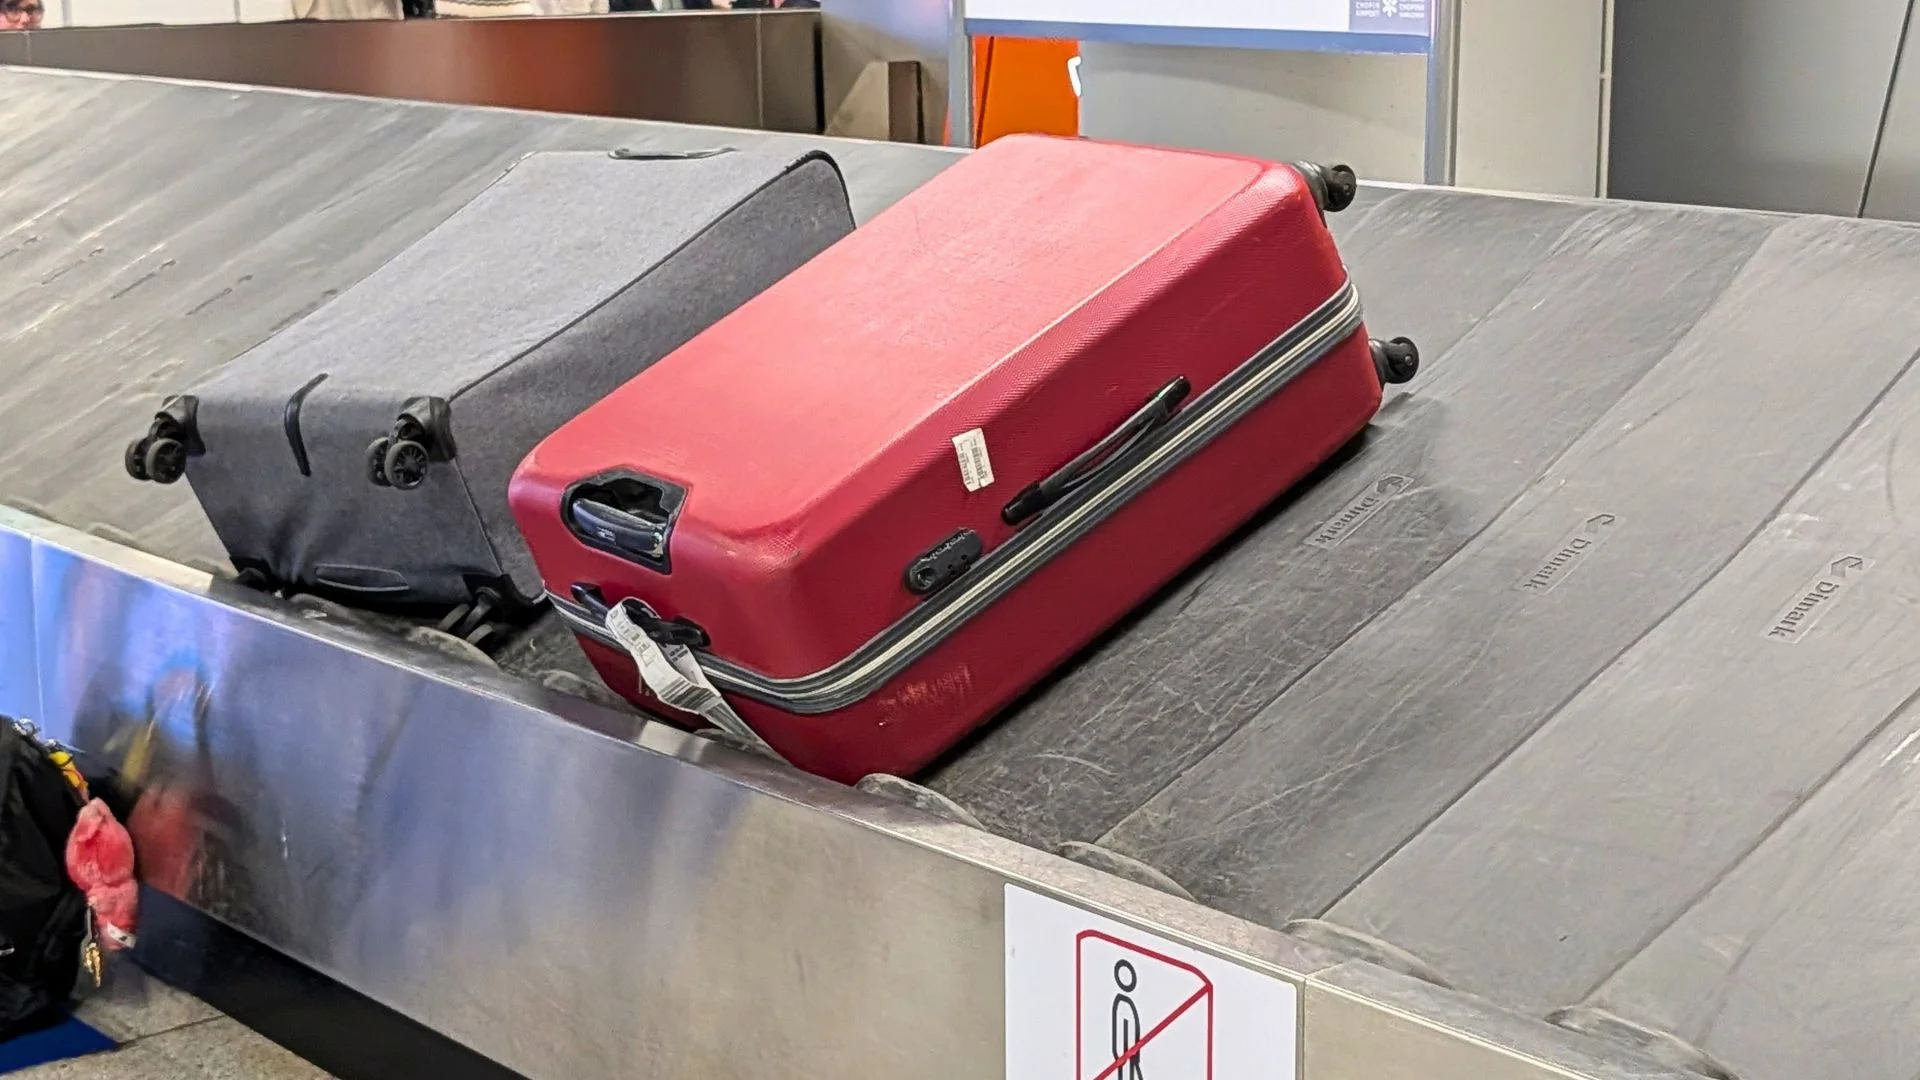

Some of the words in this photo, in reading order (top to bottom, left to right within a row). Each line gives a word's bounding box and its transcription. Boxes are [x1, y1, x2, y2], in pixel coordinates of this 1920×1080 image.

[1314, 496, 1380, 543] Dimark
[1523, 537, 1592, 589] Dimark
[1767, 581, 1840, 637] Dimark
